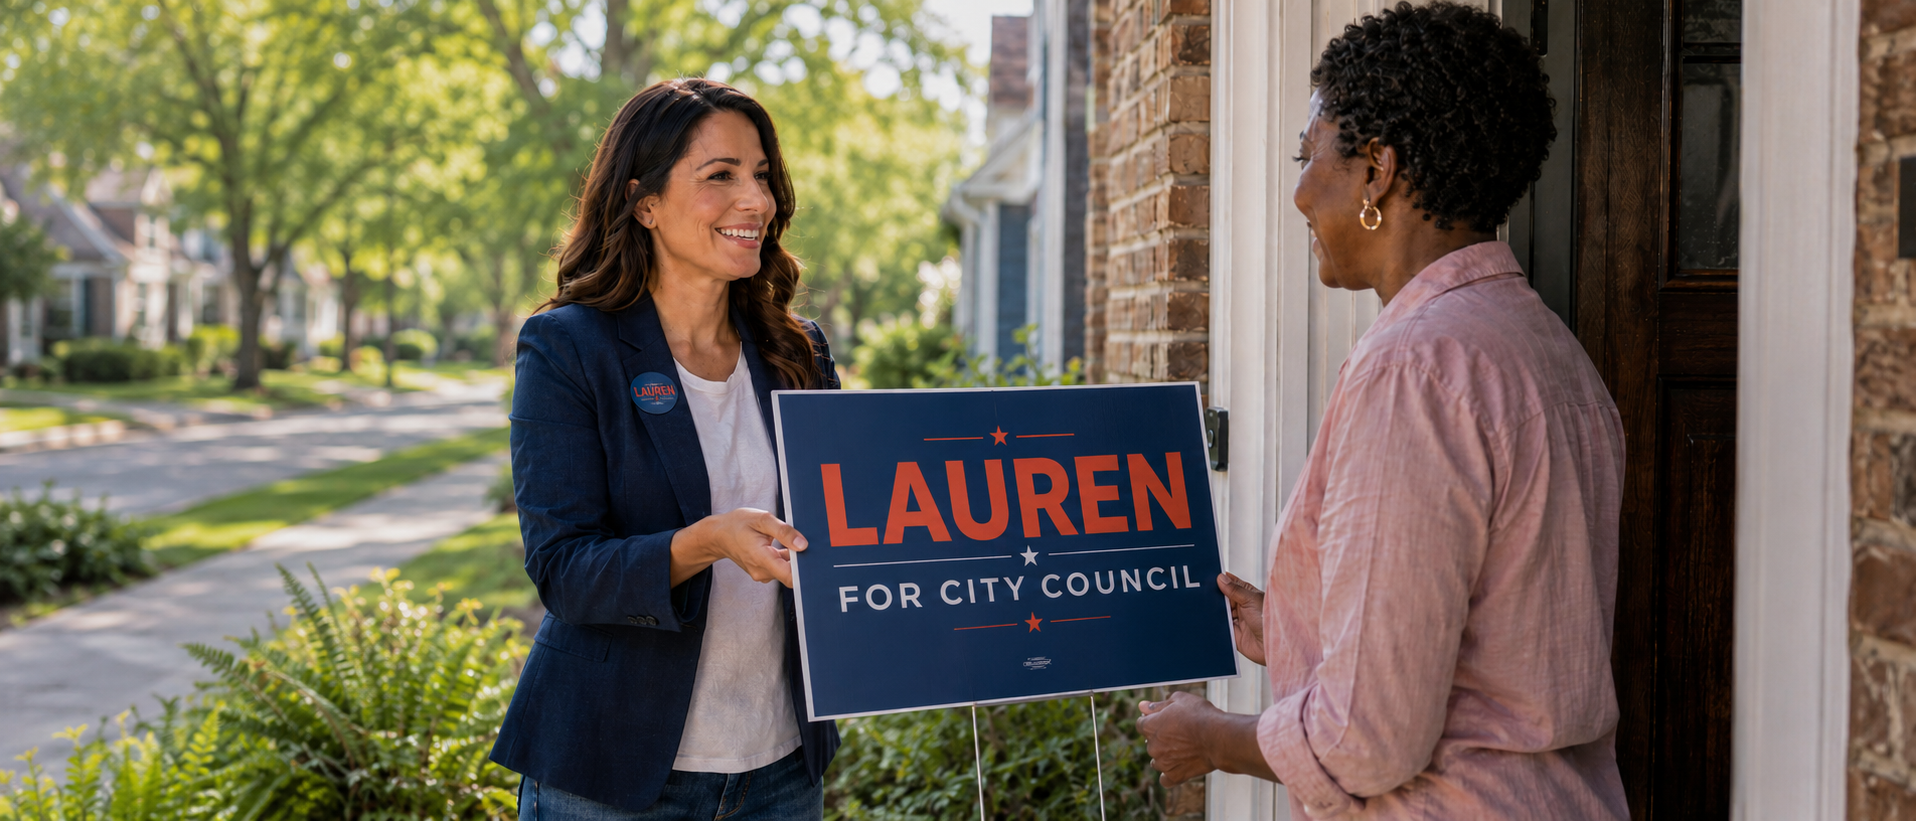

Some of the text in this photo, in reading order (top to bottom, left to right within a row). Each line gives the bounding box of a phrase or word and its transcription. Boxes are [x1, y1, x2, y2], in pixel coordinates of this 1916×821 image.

[633, 385, 675, 397] LAUREN
[820, 451, 1192, 547] LAUREN
[838, 565, 1201, 613] FOR CITY COUNCIL
